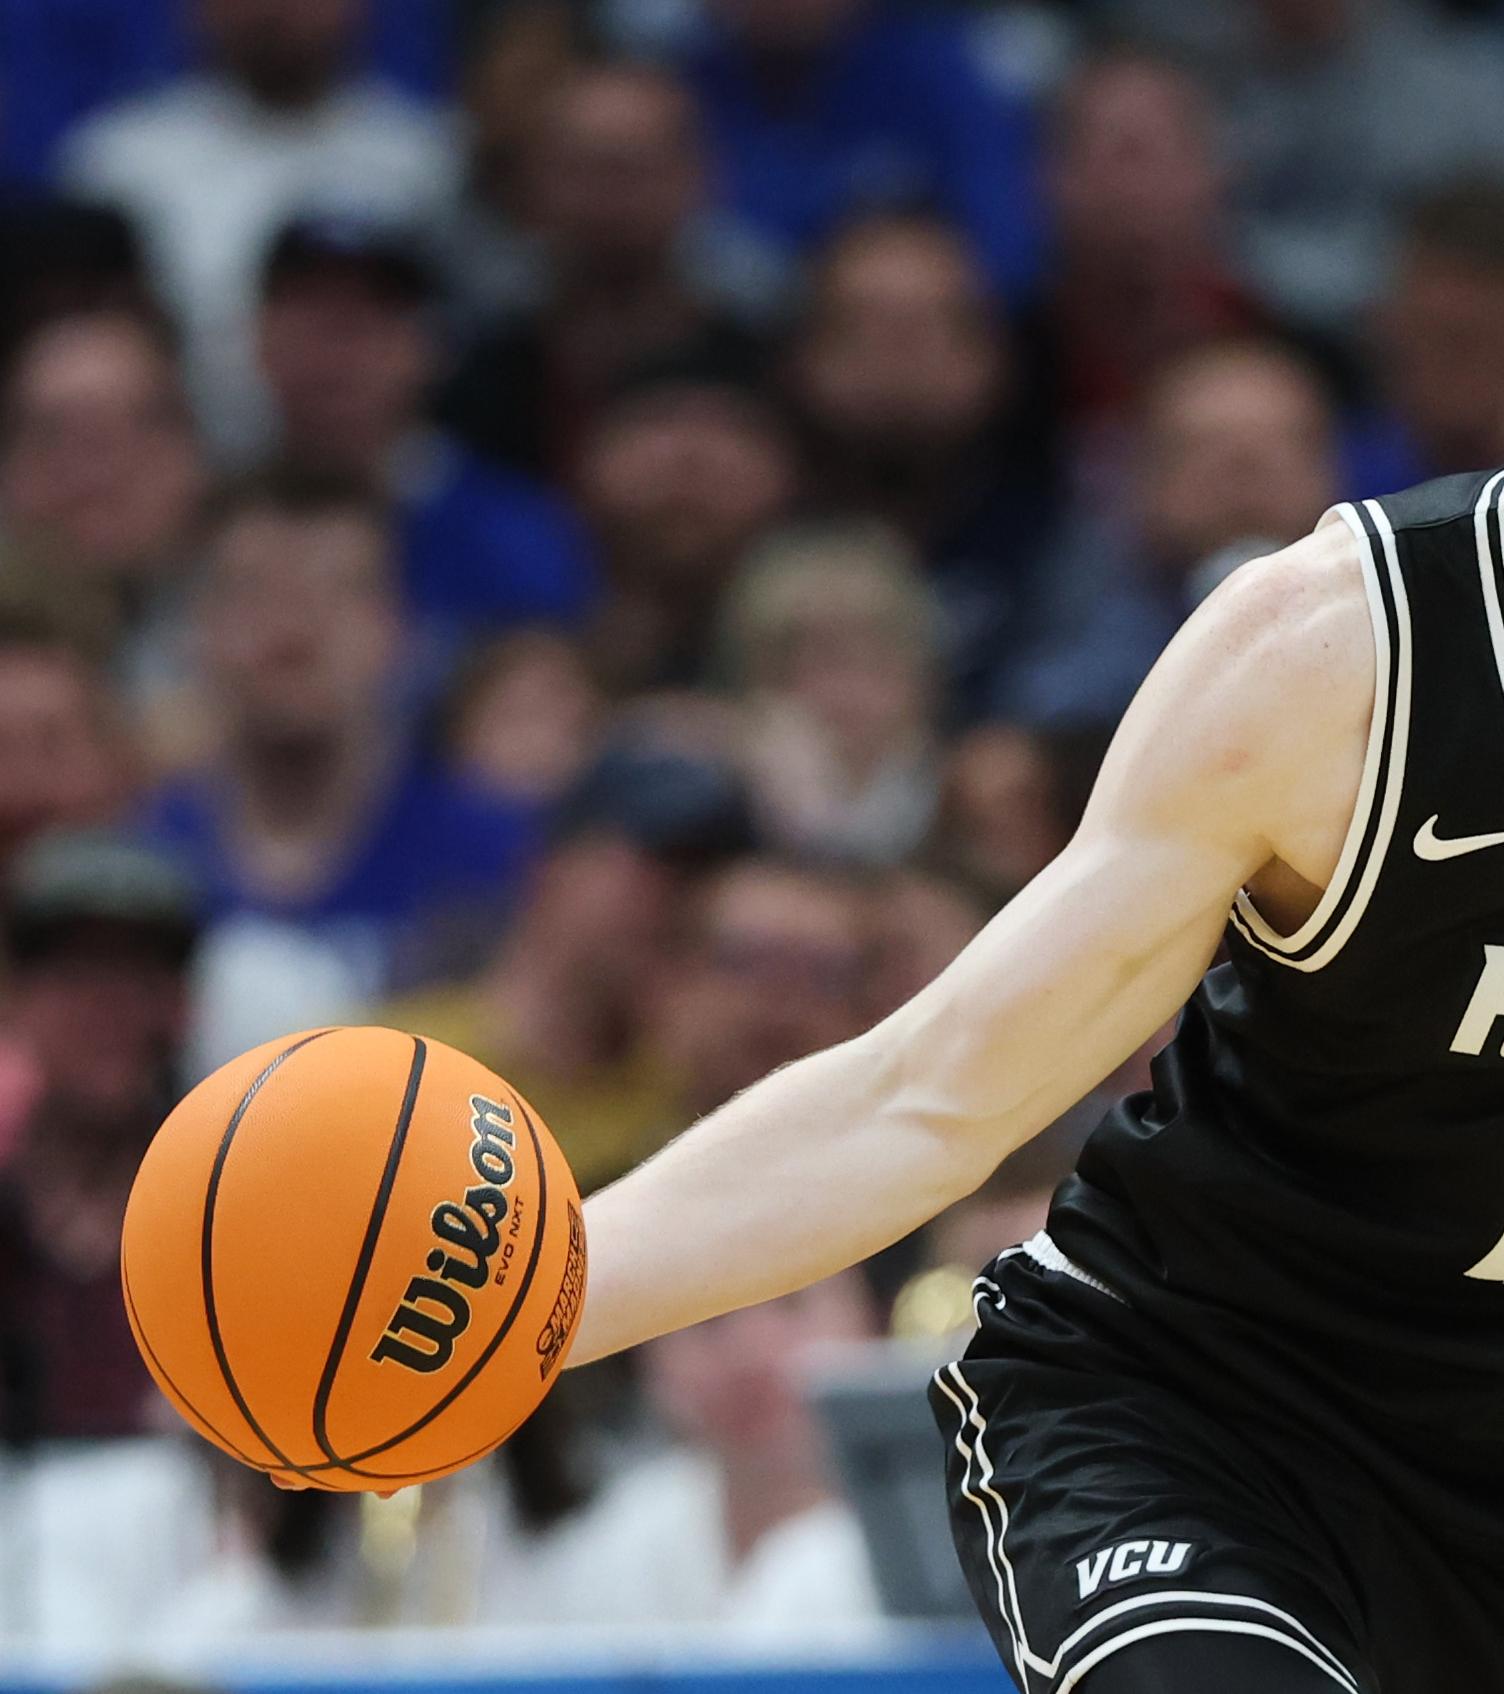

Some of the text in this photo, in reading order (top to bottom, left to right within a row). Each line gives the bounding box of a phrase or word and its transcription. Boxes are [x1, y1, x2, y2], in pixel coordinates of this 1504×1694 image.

[368, 1093, 516, 1376] Wilson
[494, 1195, 526, 1287] EVO NXT
[1076, 1540, 1192, 1600] VCU
